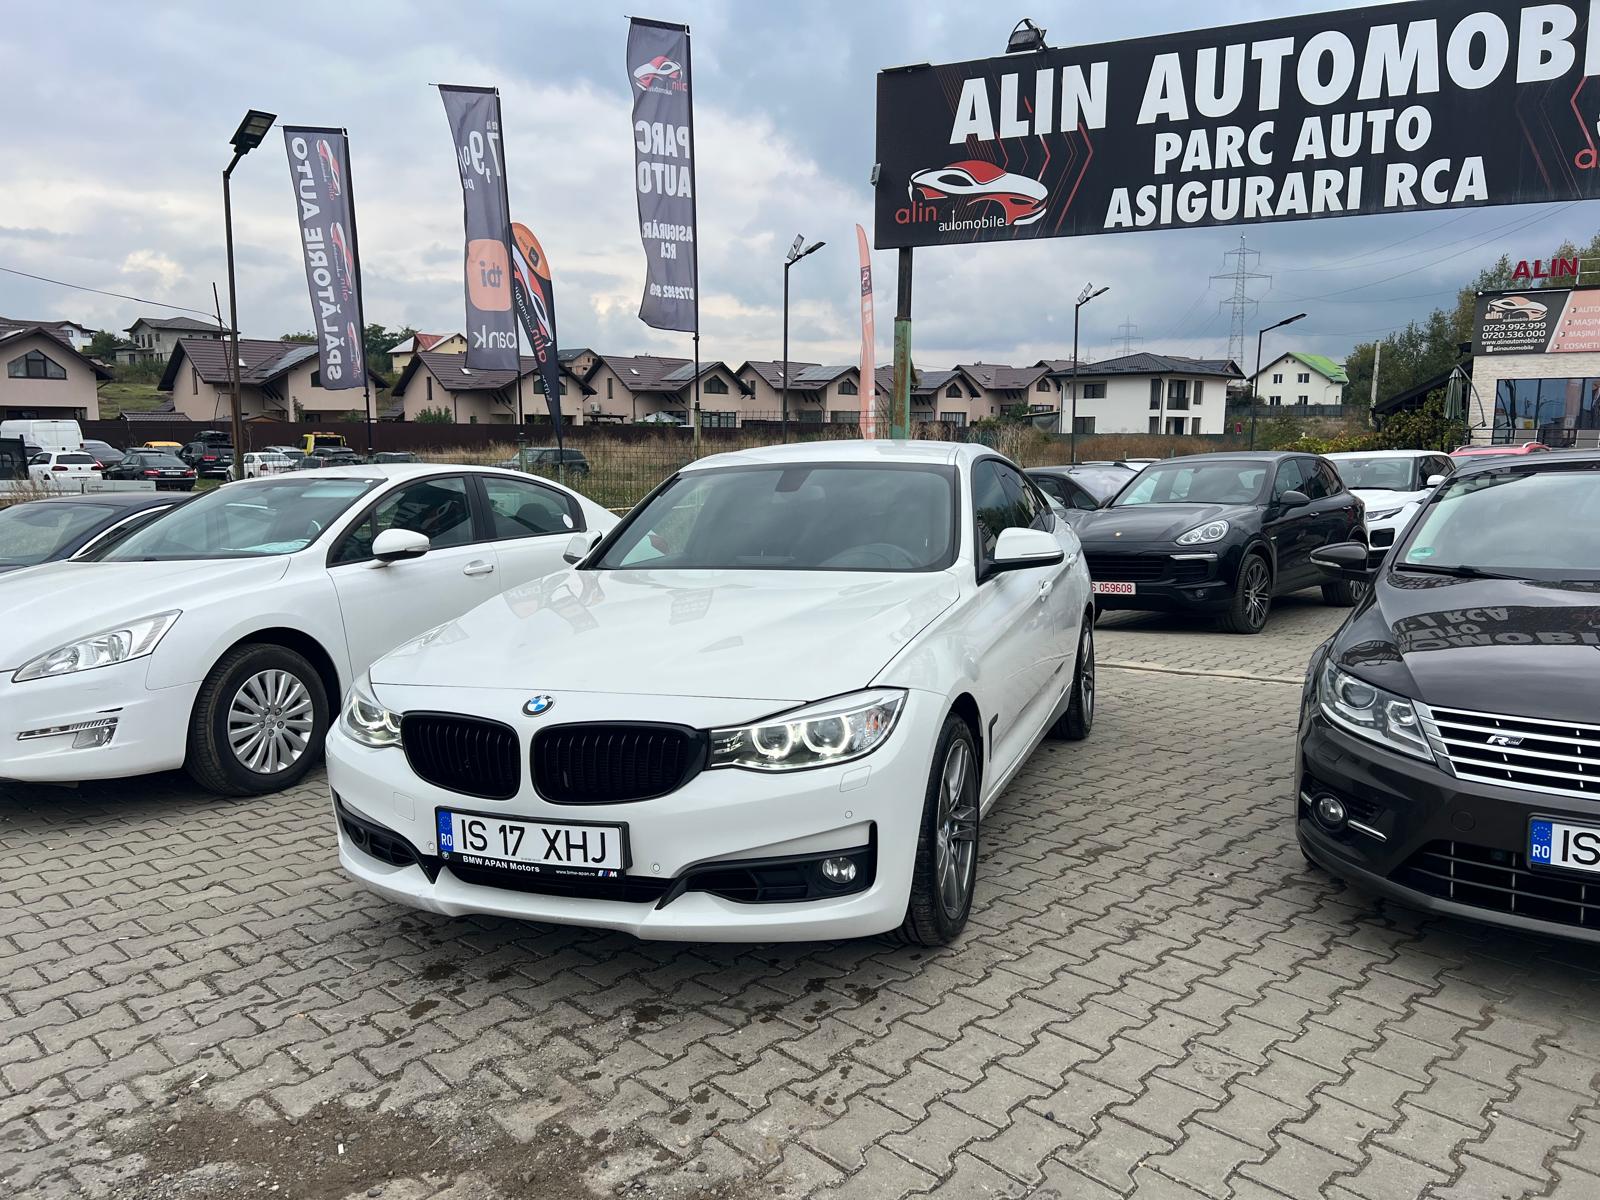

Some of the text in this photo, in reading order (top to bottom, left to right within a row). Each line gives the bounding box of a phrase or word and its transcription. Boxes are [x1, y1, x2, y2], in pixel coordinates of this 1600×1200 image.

[949, 61, 1109, 145] ALIN
[1154, 105, 1432, 175] PARC AUTO
[1103, 156, 1489, 229] ASIGURARI RCA
[895, 201, 937, 225] alin
[938, 210, 1004, 232] automobile
[1511, 256, 1578, 280] ALIN
[1482, 330, 1546, 340] 0720.536.000
[1483, 322, 1547, 332] 0729.992.999
[1099, 583, 1132, 593] 059608
[441, 833, 453, 846] RO
[461, 819, 606, 864] IS 17 XHJ
[1561, 829, 1600, 866] IS
[1532, 844, 1550, 859] RO
[462, 855, 483, 866] BMW
[484, 858, 508, 869] APAN
[509, 862, 540, 873] Motors
